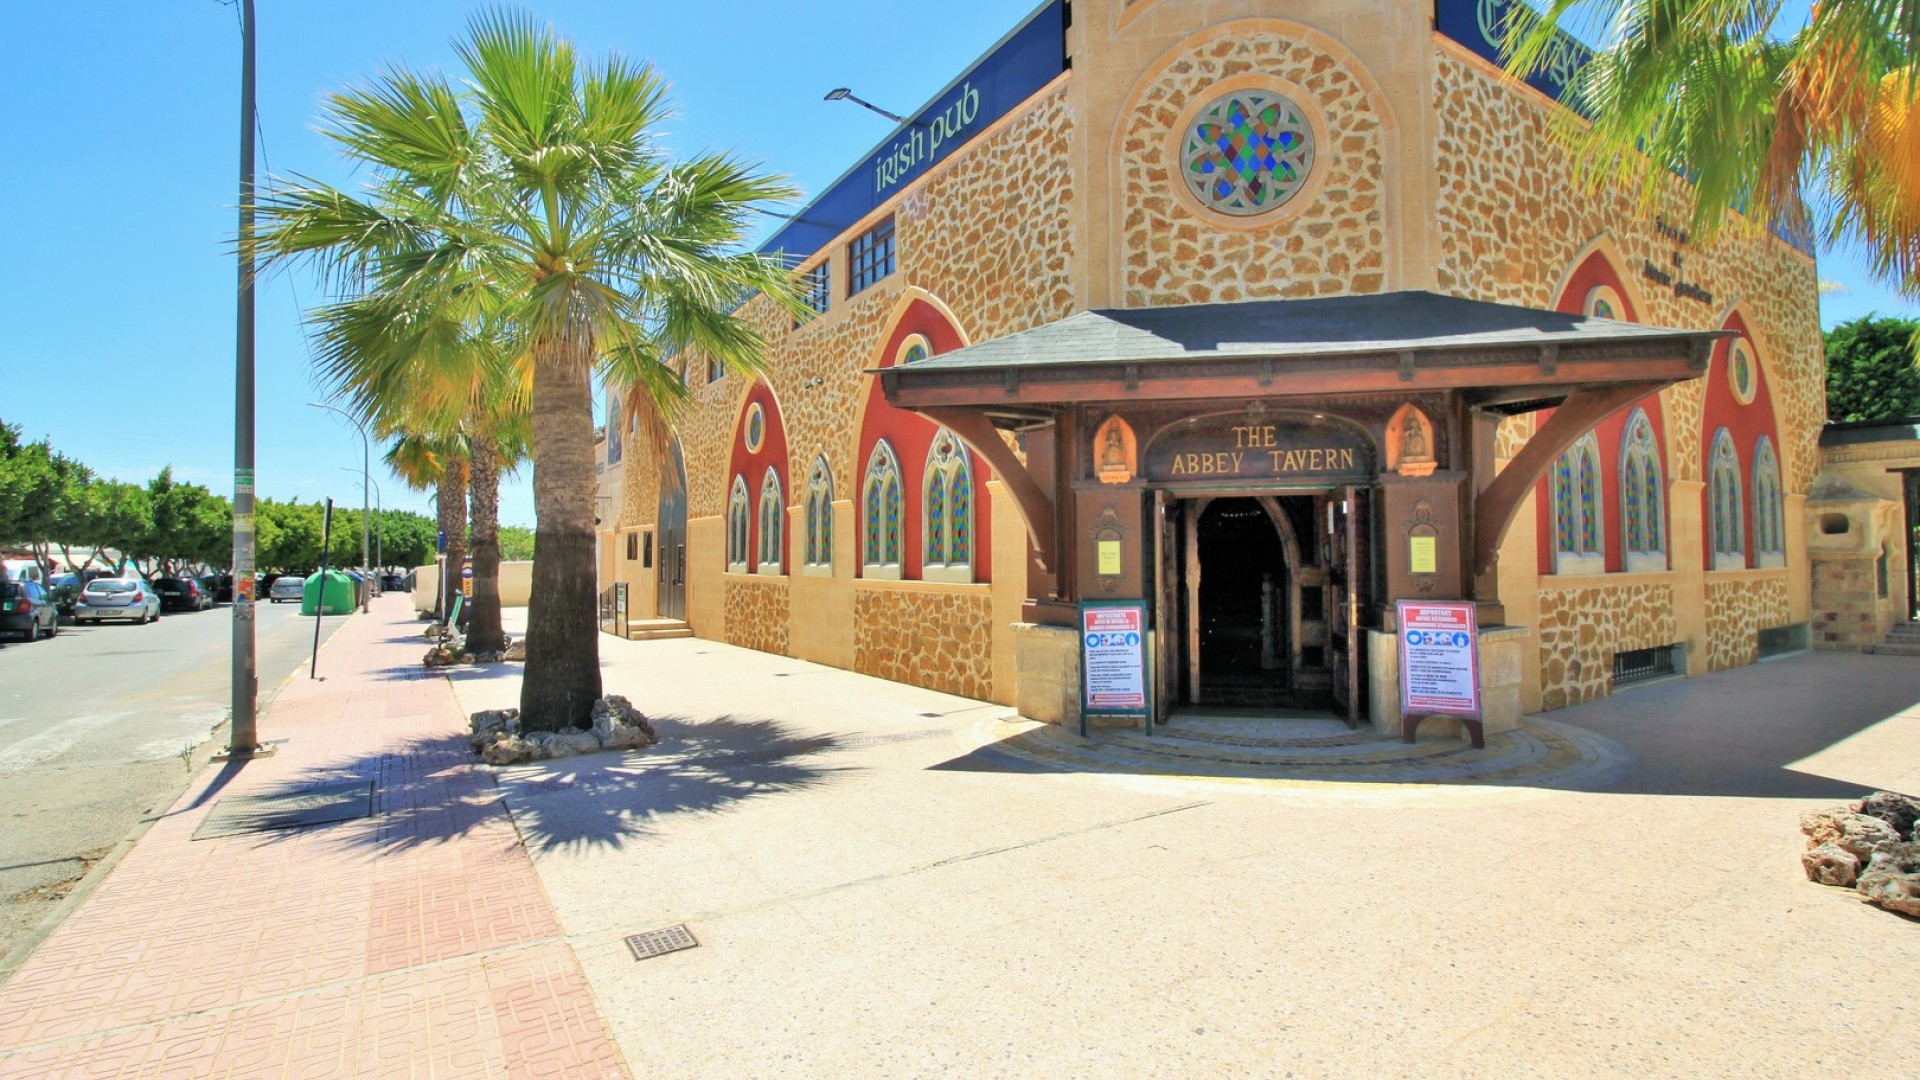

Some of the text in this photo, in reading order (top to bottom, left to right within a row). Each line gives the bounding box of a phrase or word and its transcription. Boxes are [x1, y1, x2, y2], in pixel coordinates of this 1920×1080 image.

[930, 82, 980, 162] pub
[1232, 426, 1277, 448] THE
[1171, 448, 1353, 474] ABBEY TAVERN
